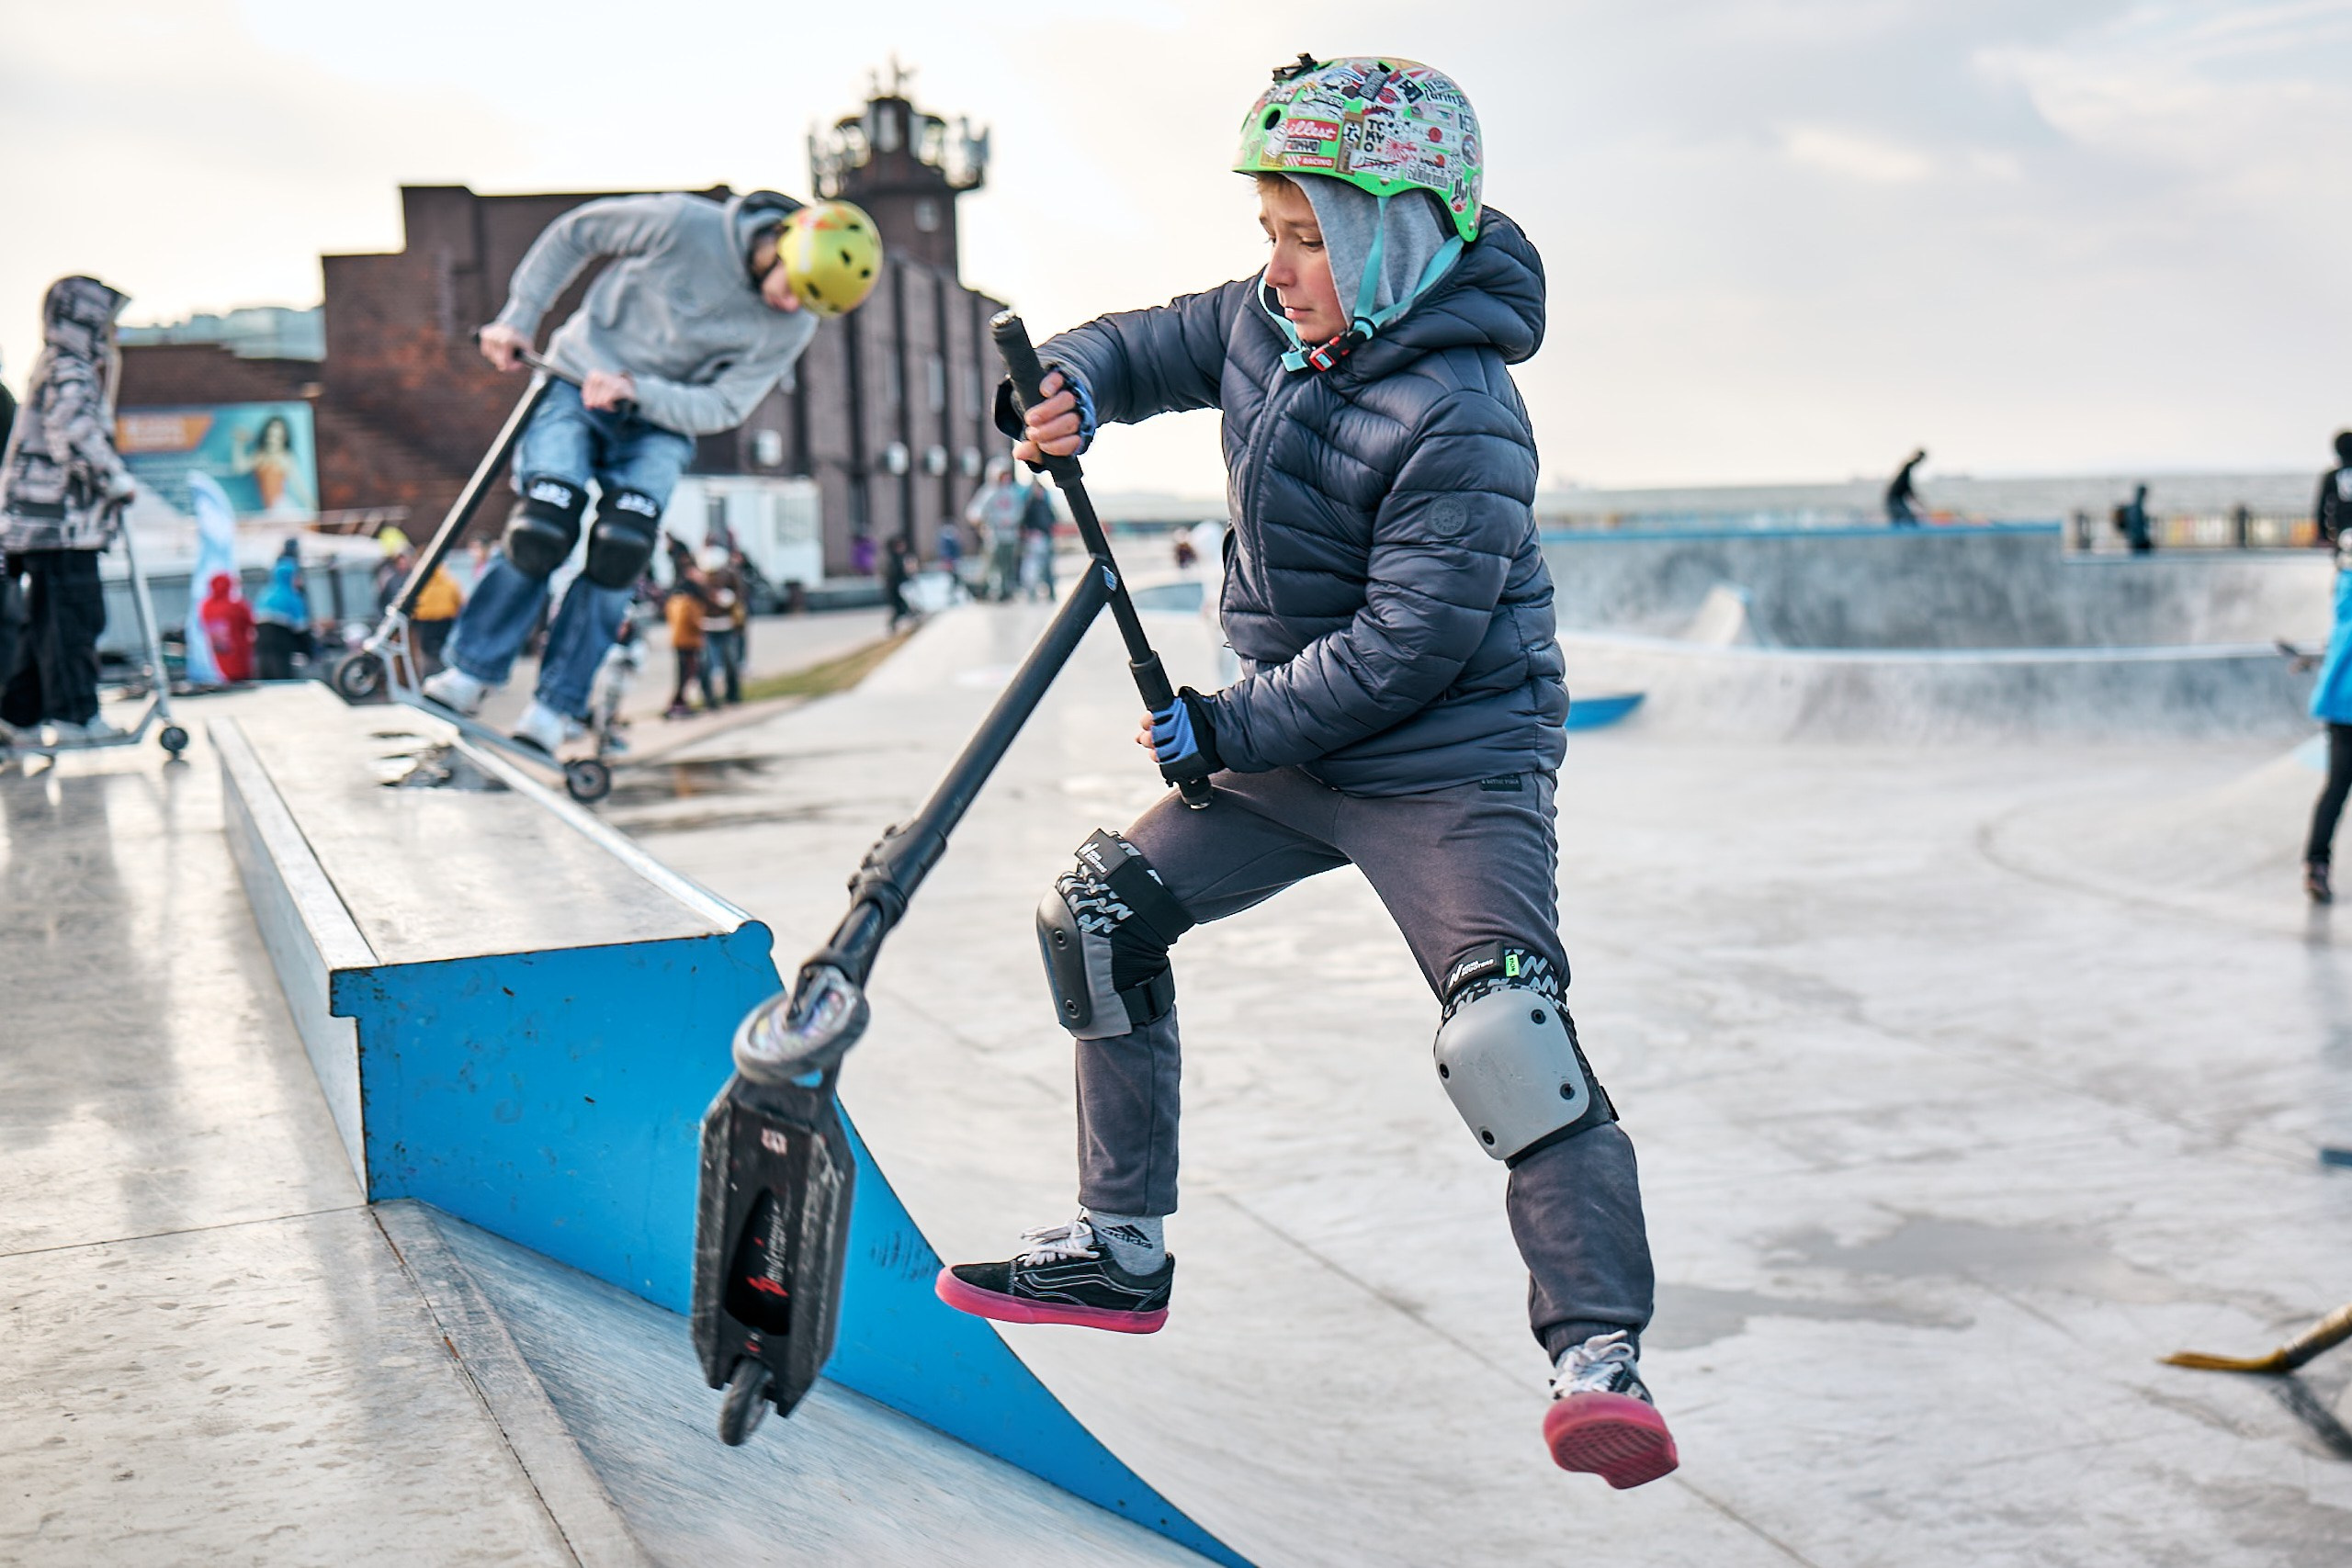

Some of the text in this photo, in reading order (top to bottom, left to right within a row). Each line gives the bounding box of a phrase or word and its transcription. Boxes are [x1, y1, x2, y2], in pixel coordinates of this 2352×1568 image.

[1287, 119, 1337, 140] illest
[1302, 158, 1333, 166] RACING
[1101, 1228, 1154, 1249] adidas
